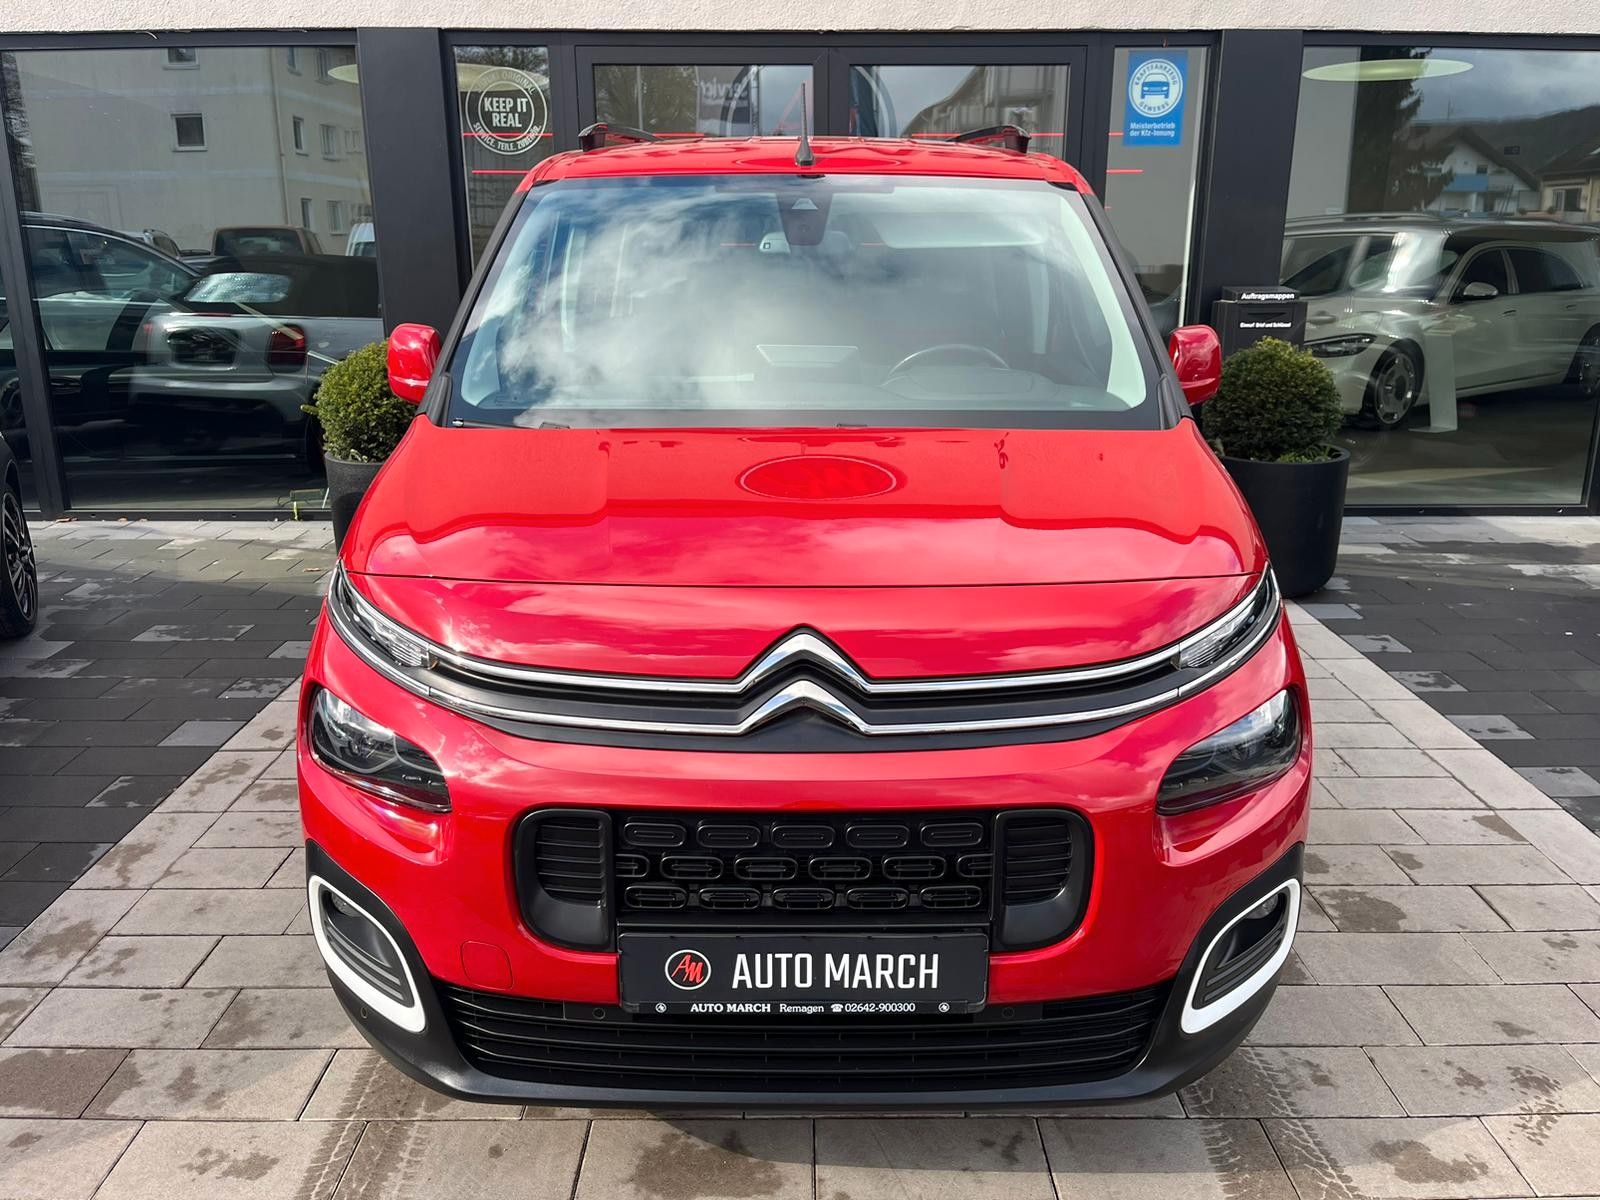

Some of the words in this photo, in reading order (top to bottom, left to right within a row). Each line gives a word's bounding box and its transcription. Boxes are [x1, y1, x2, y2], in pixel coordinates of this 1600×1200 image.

[502, 71, 536, 95] ORIGINAL
[484, 97, 514, 112] KEEP
[517, 97, 528, 112] IT
[492, 113, 522, 127] REAL
[1241, 292, 1295, 301] Auftragsmappen
[731, 953, 813, 989] AUTO
[825, 953, 939, 989] MARCH
[690, 1003, 724, 1013] AUTO
[726, 1003, 771, 1013] MARCH
[779, 1004, 824, 1014] Remagen
[845, 1003, 916, 1013] 02642-900300
